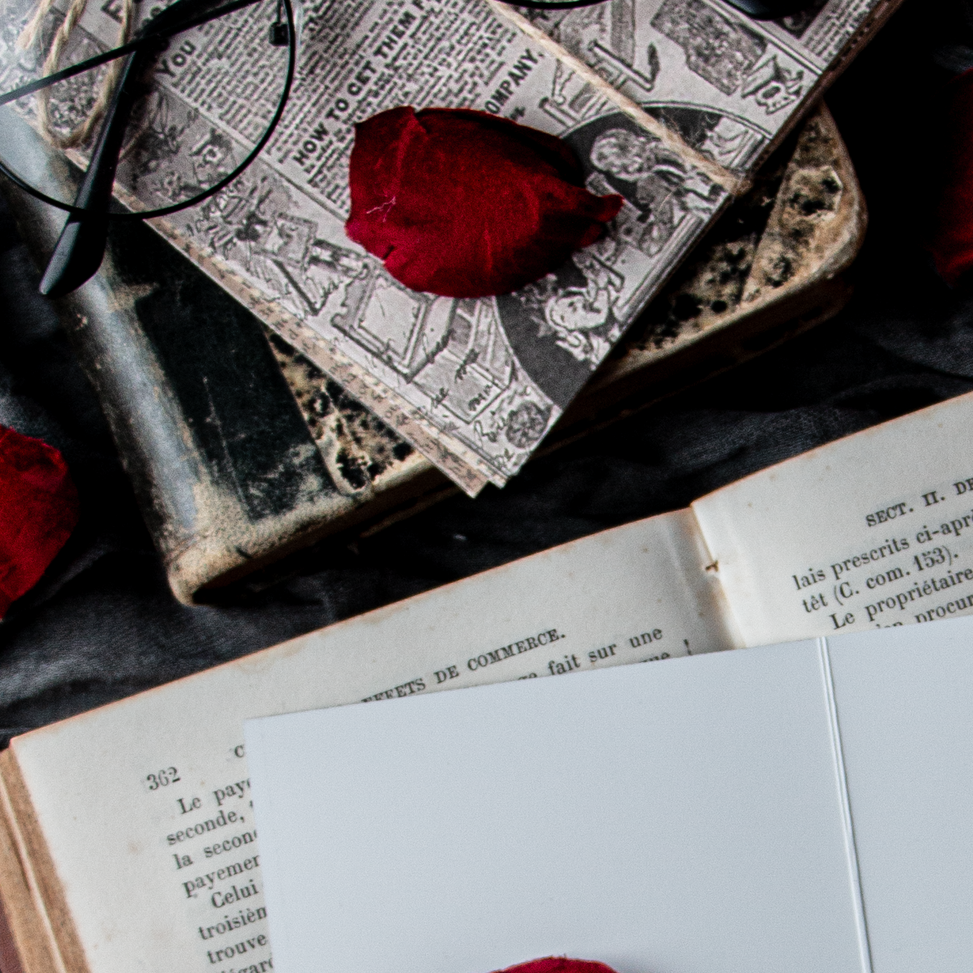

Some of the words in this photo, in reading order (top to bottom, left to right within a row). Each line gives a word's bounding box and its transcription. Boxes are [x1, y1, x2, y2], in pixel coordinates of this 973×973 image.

[292, 121, 330, 167] HOW
[325, 97, 350, 123] TO
[373, 11, 417, 60] THEM
[865, 503, 914, 528] SECT.
[792, 568, 826, 590] lais
[830, 538, 910, 580] prescrits
[802, 592, 829, 614] têt
[865, 565, 911, 590] com.
[912, 545, 959, 572] 153).
[829, 612, 855, 630] Le
[434, 664, 459, 685] DE
[466, 628, 566, 672] COMMERCE.
[547, 654, 581, 677] fait
[588, 643, 618, 663] sur
[629, 627, 664, 650] une
[146, 766, 181, 791] 362
[177, 797, 202, 815] Le
[167, 810, 246, 846] seconde,
[173, 853, 194, 870] la
[211, 879, 260, 909] Celui
[207, 934, 267, 965] trouve
